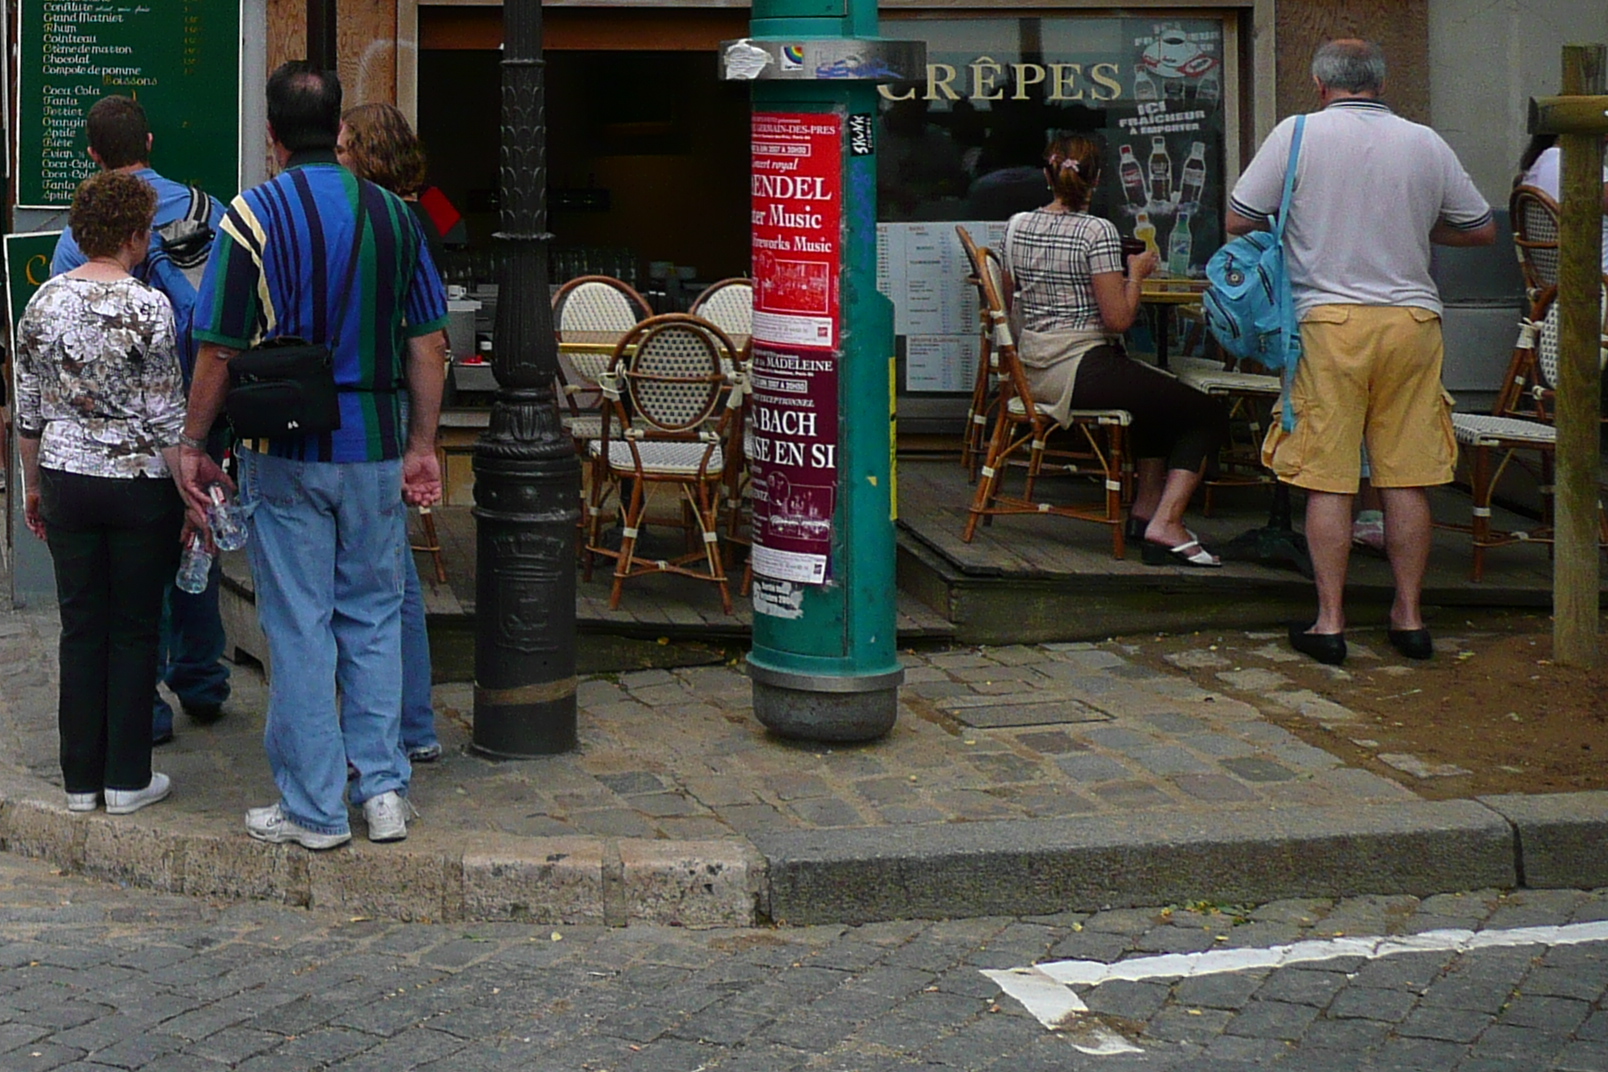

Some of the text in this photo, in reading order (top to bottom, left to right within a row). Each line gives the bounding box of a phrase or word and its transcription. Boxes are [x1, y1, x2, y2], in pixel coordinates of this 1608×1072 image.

[769, 204, 822, 229] Music
[793, 236, 832, 252] Music
[767, 357, 833, 371] MADELEINE
[760, 407, 818, 437] BACH
[774, 440, 806, 467] EN
[812, 443, 836, 469] SI
